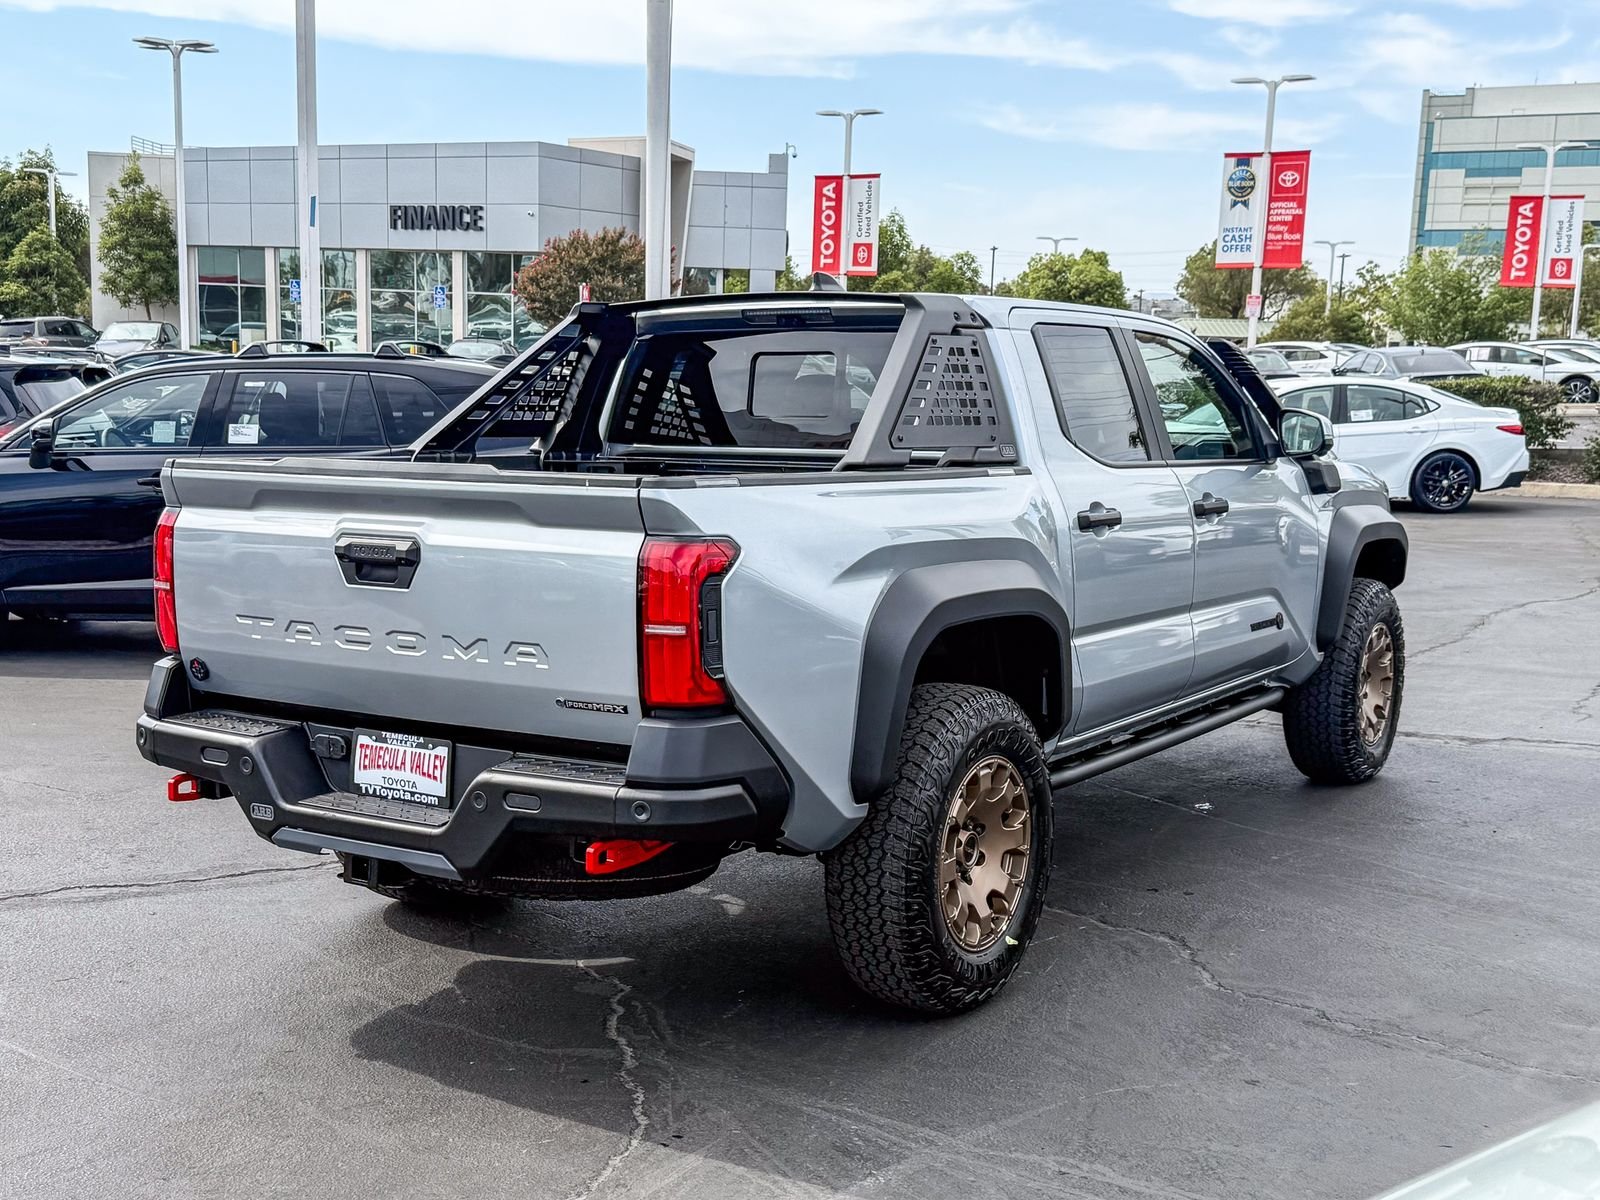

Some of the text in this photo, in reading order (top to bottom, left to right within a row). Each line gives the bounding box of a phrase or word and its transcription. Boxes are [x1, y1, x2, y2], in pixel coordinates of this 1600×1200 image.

[389, 205, 484, 232] FINANCE
[856, 201, 864, 238] Certified
[864, 180, 873, 238] Used Vehicles
[819, 181, 837, 268] TOYOTA
[1222, 226, 1253, 234] INSTANT
[1267, 224, 1289, 233] Kelley
[1564, 201, 1575, 254] Used Vehicles
[1221, 244, 1252, 253] OFFER
[1222, 234, 1253, 243] CASH
[1510, 201, 1535, 280] TOYOTA
[1554, 220, 1564, 254] Certified
[353, 545, 393, 558] TOYOTA
[235, 613, 549, 669] TACOMA
[381, 731, 424, 744] TEMECULA
[386, 738, 418, 748] VALLEY
[358, 743, 446, 784] TEMECULA VALLEY
[359, 783, 439, 806] TVToyota.com
[381, 776, 418, 790] TOYOTA
[253, 806, 271, 818] ARB
